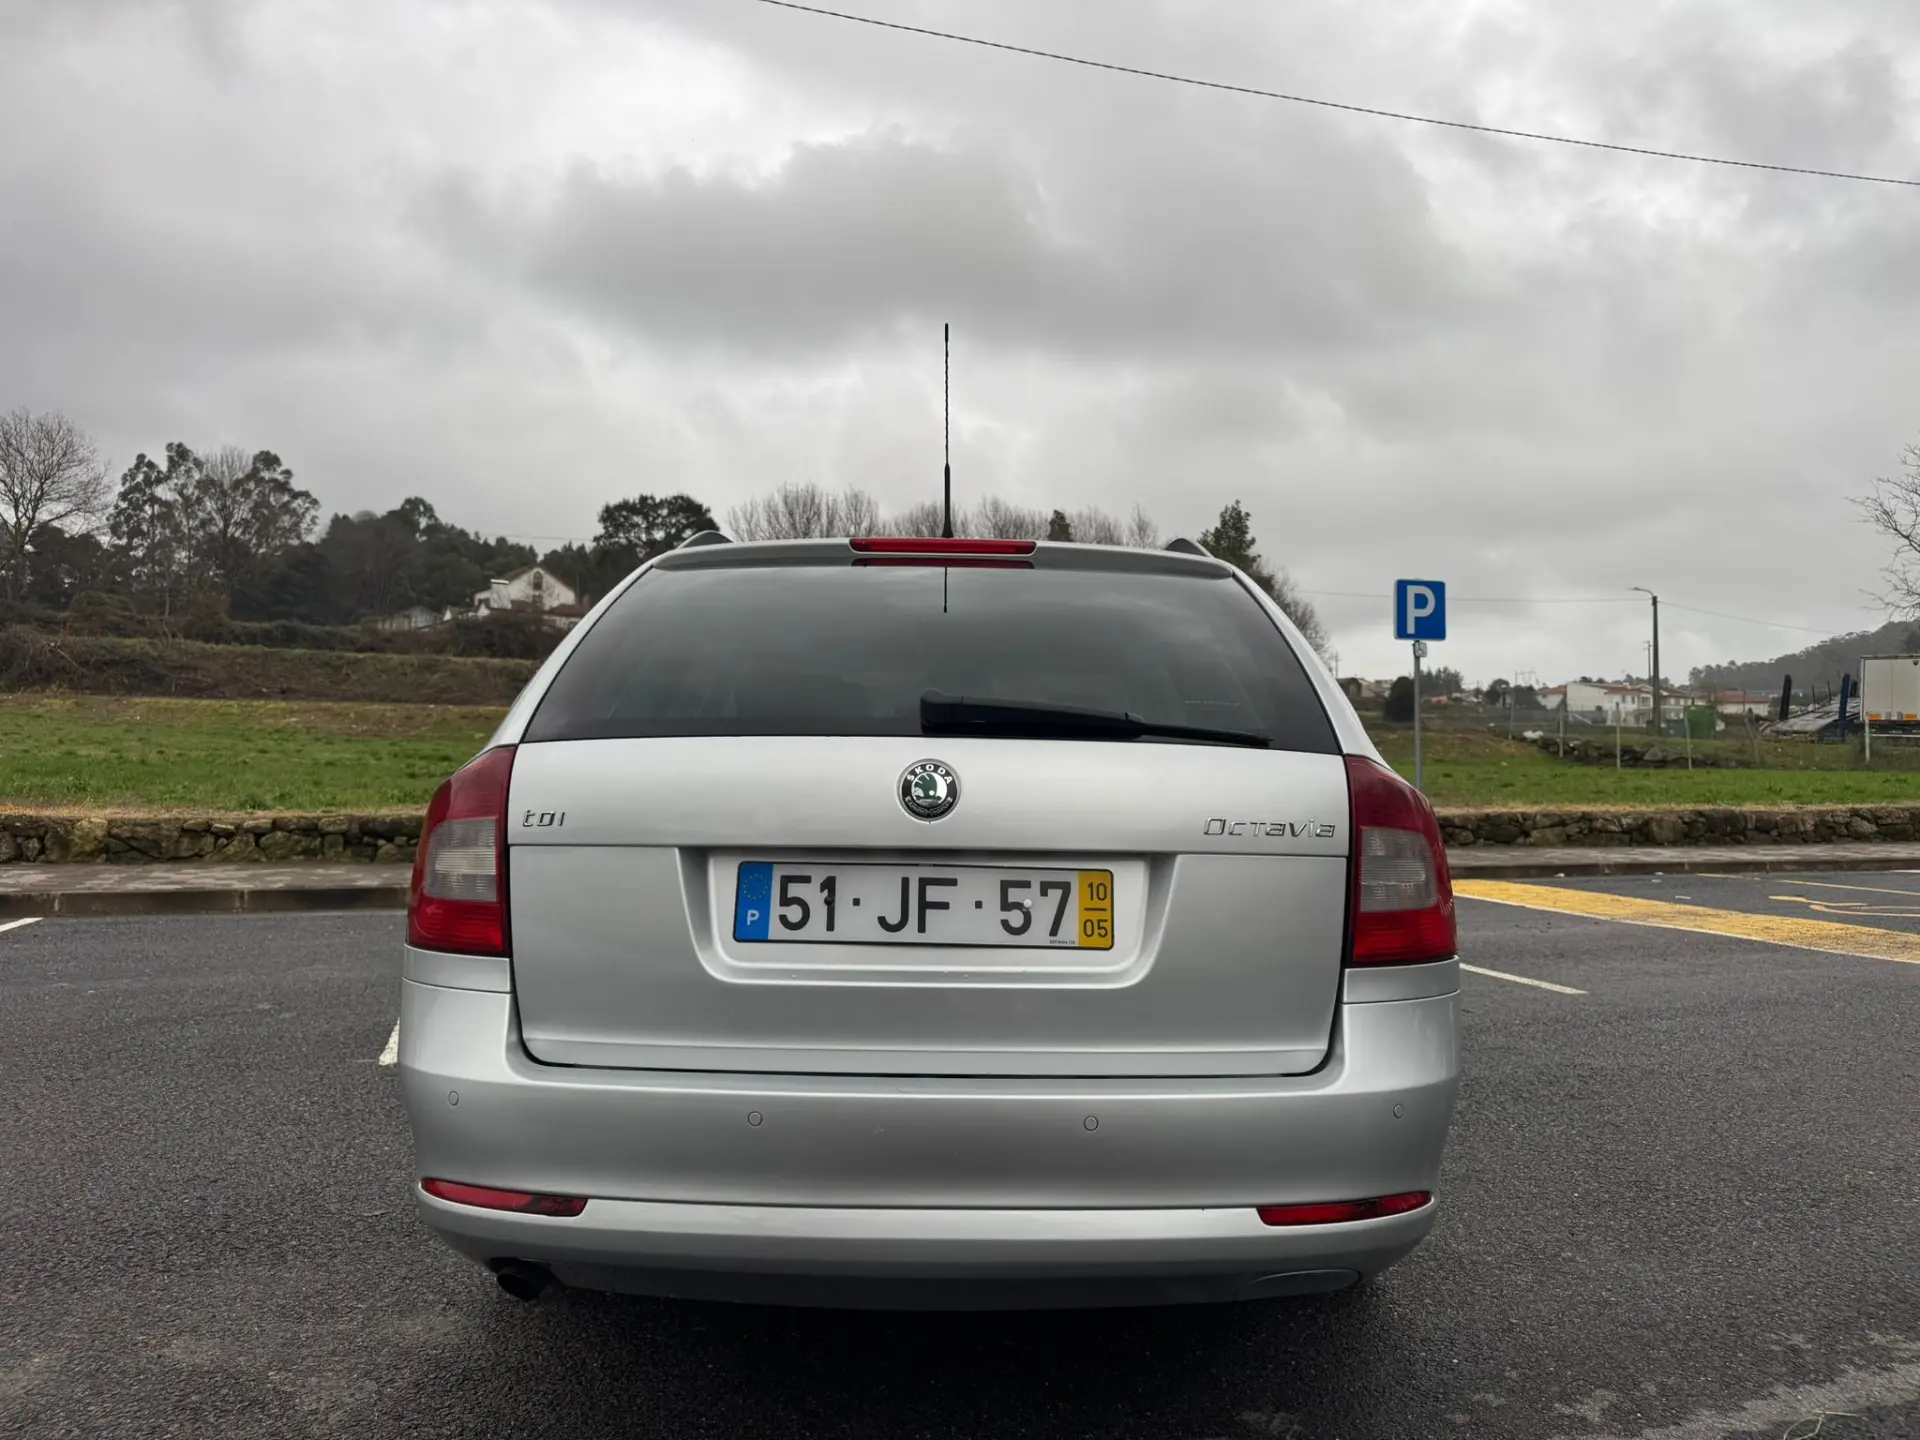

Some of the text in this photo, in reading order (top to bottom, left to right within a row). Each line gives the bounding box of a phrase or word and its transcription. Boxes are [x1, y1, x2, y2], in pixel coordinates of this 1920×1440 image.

[1406, 585, 1436, 634] P
[1203, 818, 1336, 838] Octavia
[1087, 881, 1108, 902] 10
[746, 909, 760, 927] P
[1083, 918, 1109, 938] 05
